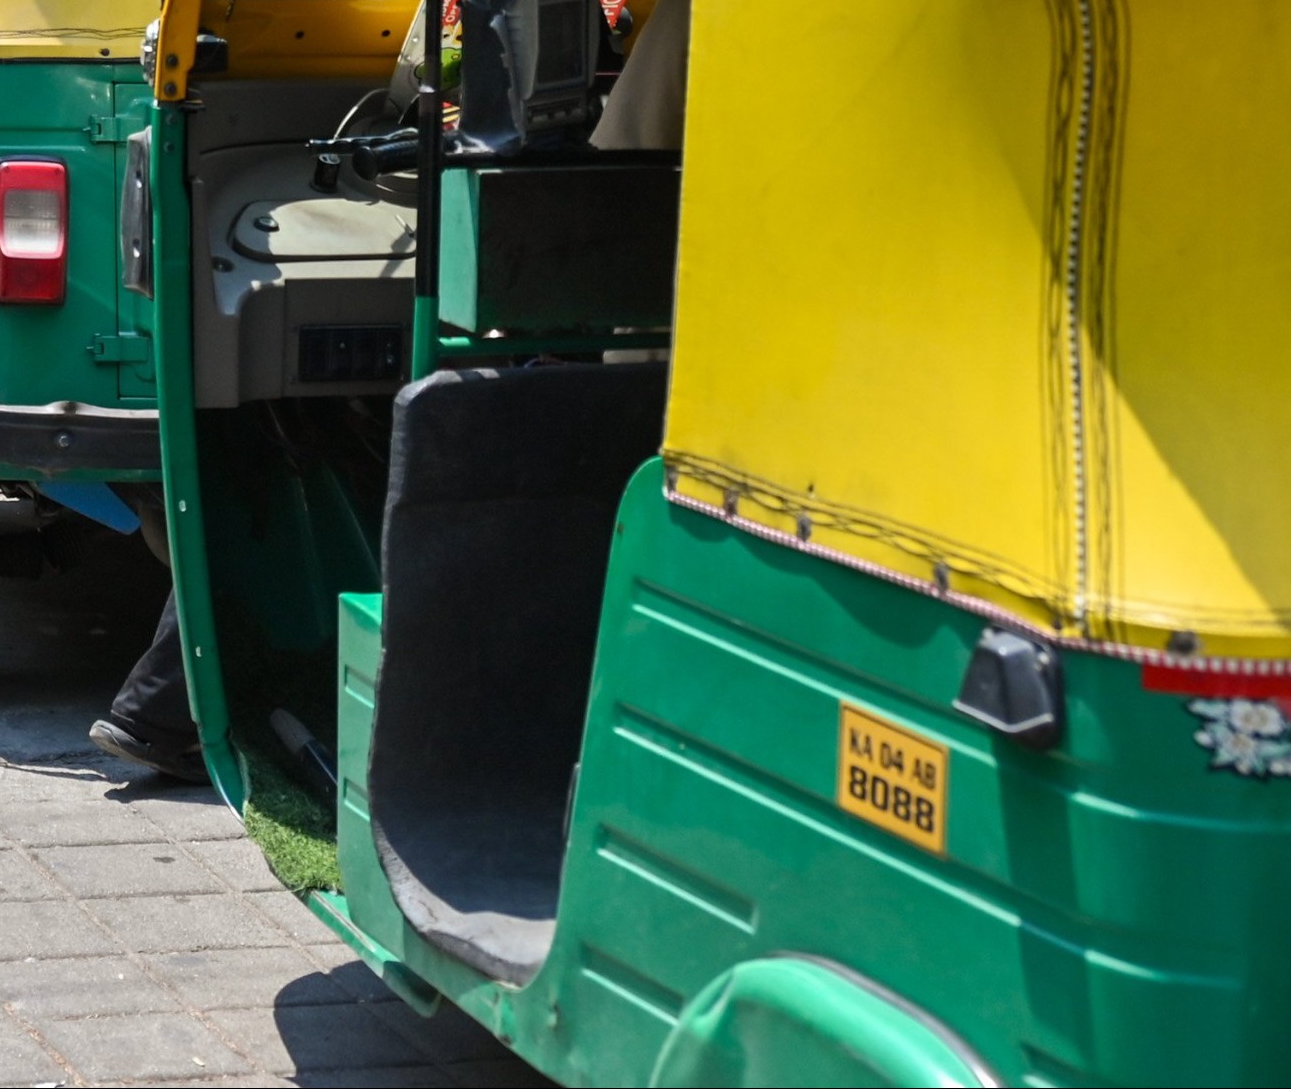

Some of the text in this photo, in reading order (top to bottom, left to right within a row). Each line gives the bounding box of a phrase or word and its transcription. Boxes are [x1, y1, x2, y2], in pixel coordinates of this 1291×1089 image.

[850, 728, 936, 791] KA 04 AB
[850, 765, 934, 834] 8088
